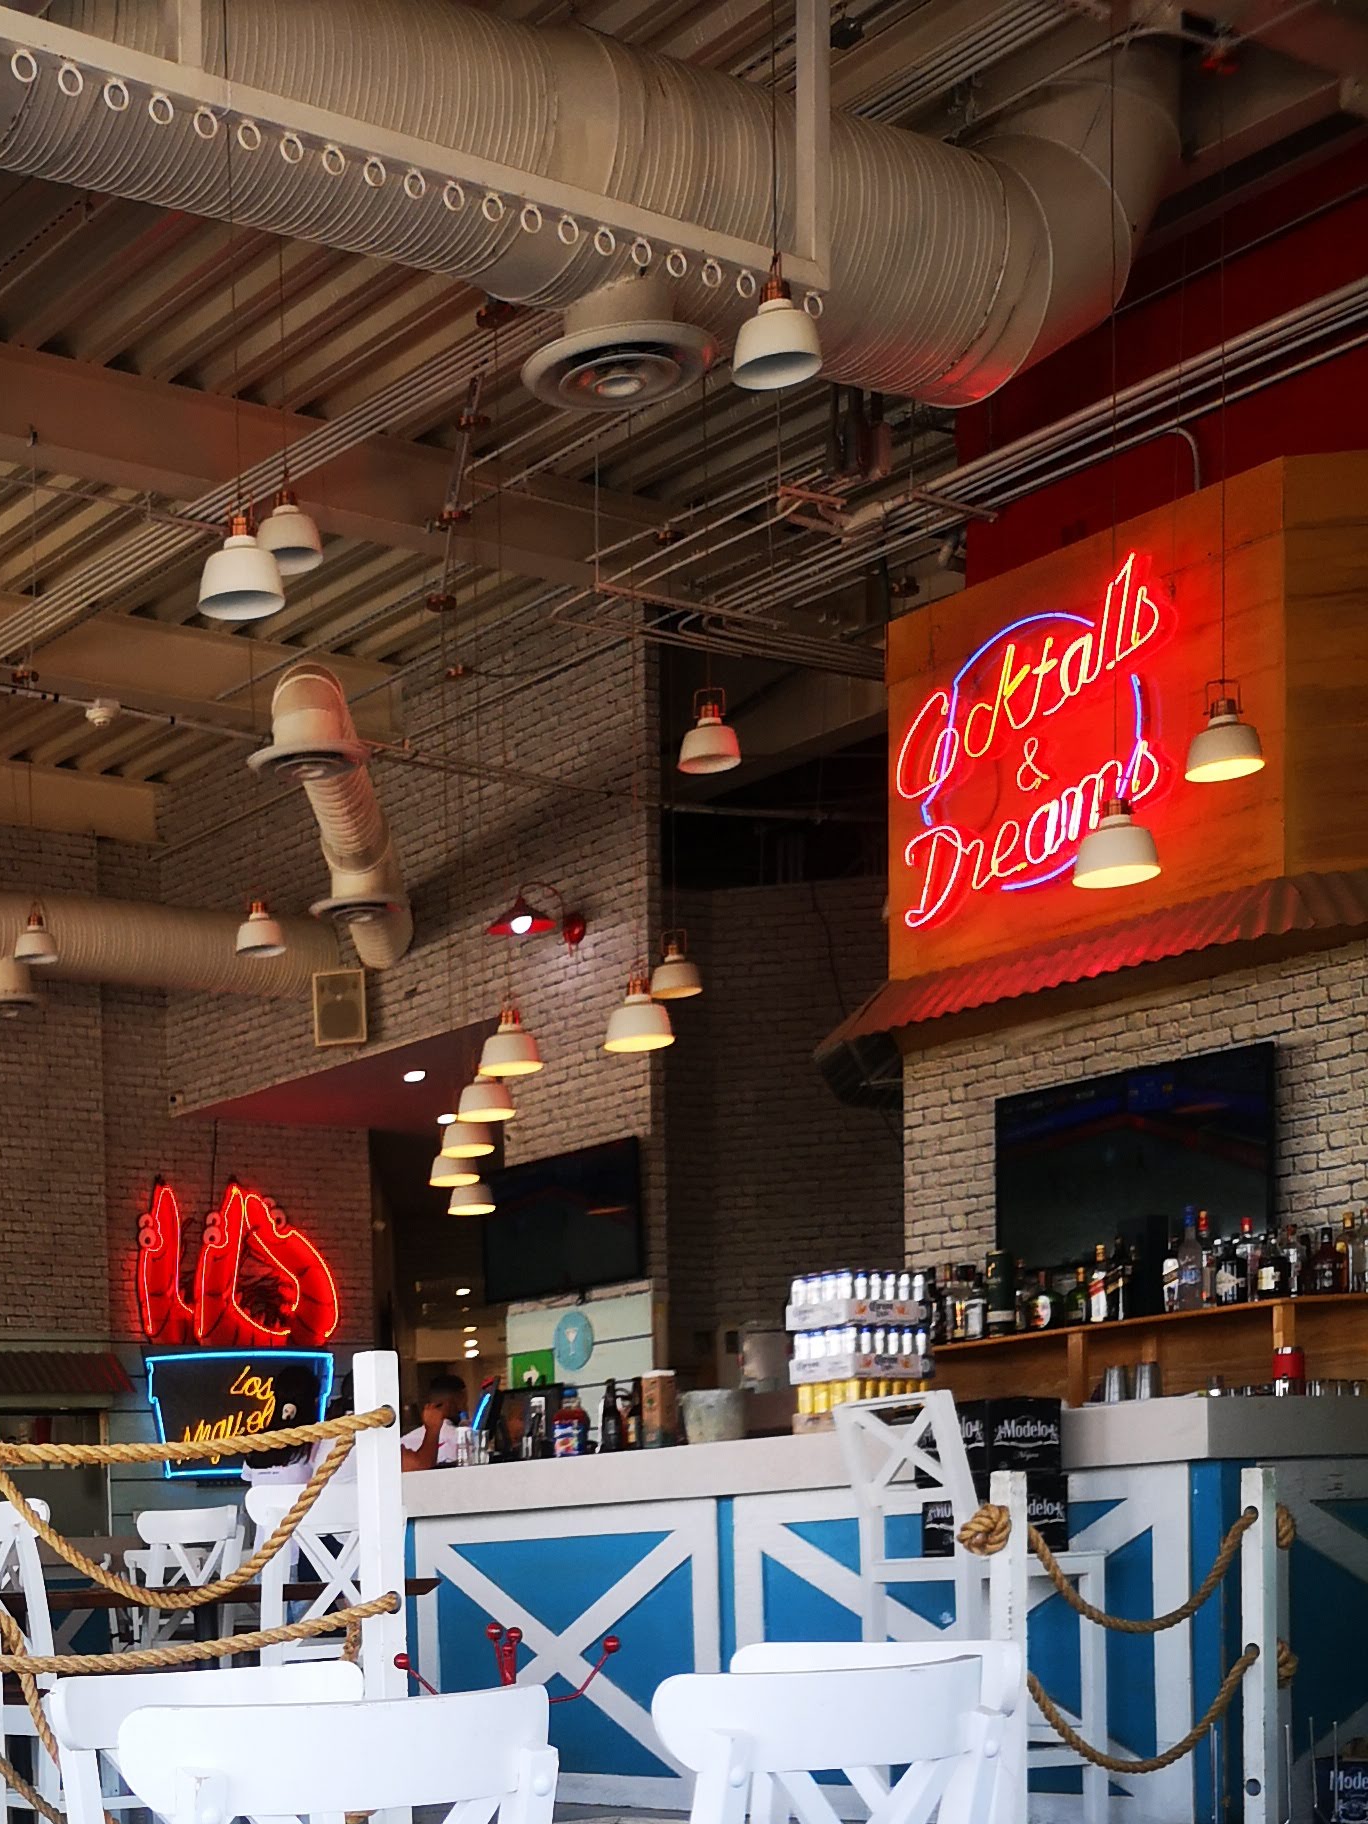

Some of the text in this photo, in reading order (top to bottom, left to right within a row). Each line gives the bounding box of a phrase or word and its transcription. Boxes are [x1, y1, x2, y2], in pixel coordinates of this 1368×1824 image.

[1016, 735, 1051, 792] &
[904, 739, 1160, 928] Dreams
[230, 1365, 274, 1400] Los
[1003, 1419, 1049, 1439] Modelo
[1028, 1499, 1056, 1516] delo
[1329, 1770, 1368, 1791] Mode
